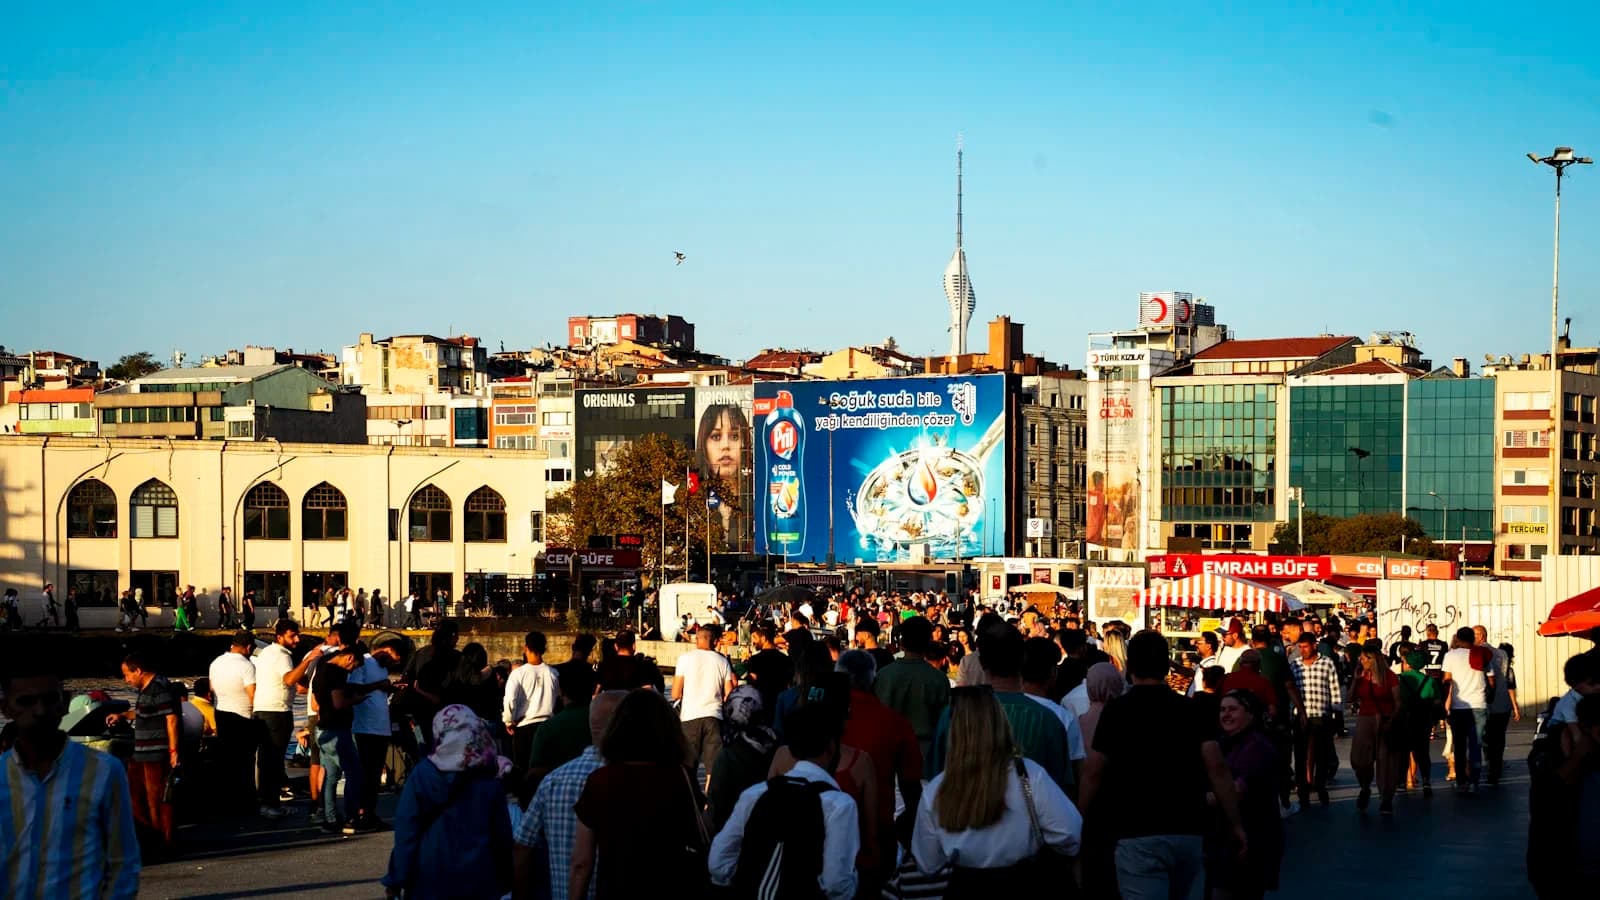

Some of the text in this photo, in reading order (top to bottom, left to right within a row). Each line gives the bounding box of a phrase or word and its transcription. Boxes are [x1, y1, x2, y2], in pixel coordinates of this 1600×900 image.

[583, 393, 635, 408] ORIGINALS
[831, 390, 941, 410] Soğuk suda bile
[815, 414, 956, 431] yağı kendiliğinden çözer
[774, 427, 793, 450] Pril
[580, 552, 614, 565] BÜFE
[1203, 561, 1267, 575] EMRAH
[1272, 560, 1319, 576] BÜFE
[1391, 562, 1429, 576] BÜFE
[1430, 651, 1439, 665] 7
